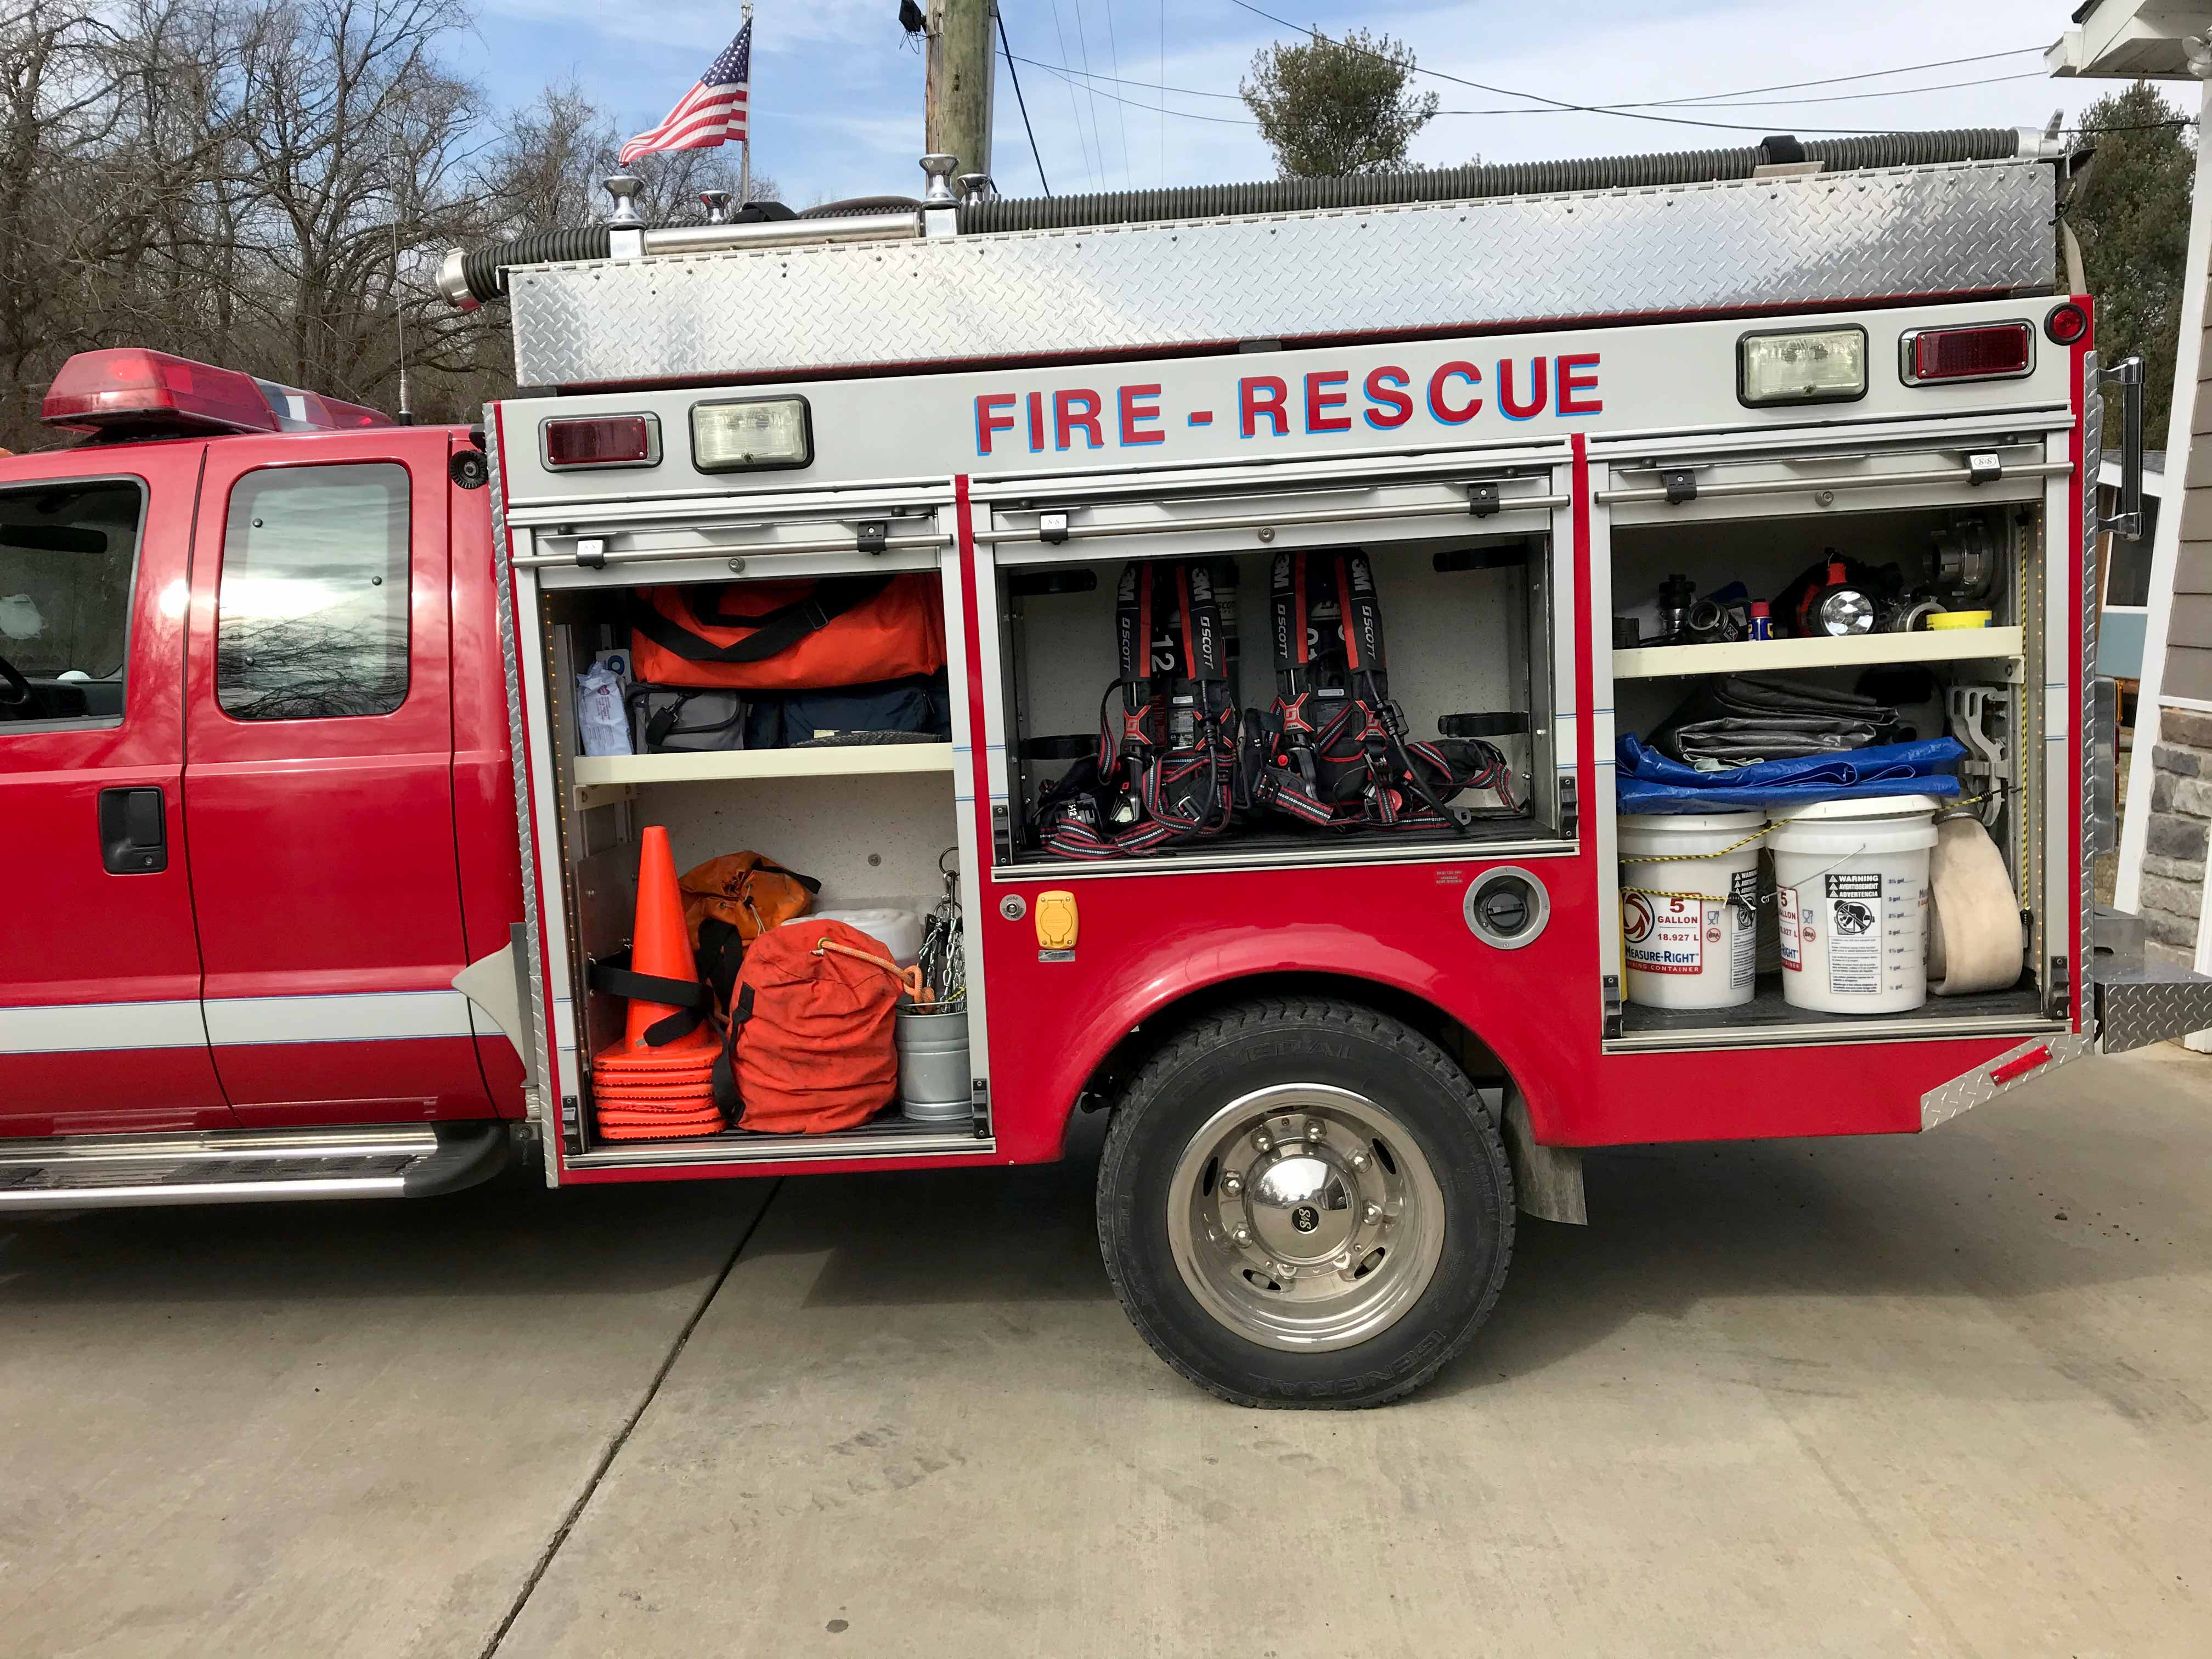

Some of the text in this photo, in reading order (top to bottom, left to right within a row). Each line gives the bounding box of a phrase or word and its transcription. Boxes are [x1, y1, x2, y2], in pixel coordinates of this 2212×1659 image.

[974, 383, 1165, 456] FIRE
[1238, 353, 1604, 438] RESCUE
[1119, 567, 1136, 601] 3M
[1192, 567, 1212, 602] 3M
[1274, 554, 1289, 588] 3M
[1351, 558, 1372, 591] 3M
[1122, 628, 1131, 672] SCOTT
[1152, 635, 1175, 672] 12
[1201, 628, 1214, 670] SCOTT
[1278, 616, 1288, 659] SCOTT
[1364, 617, 1376, 660] SCOTT
[1669, 898, 1685, 913] 5
[1781, 892, 1788, 907] 5
[1657, 916, 1698, 924] GALLON
